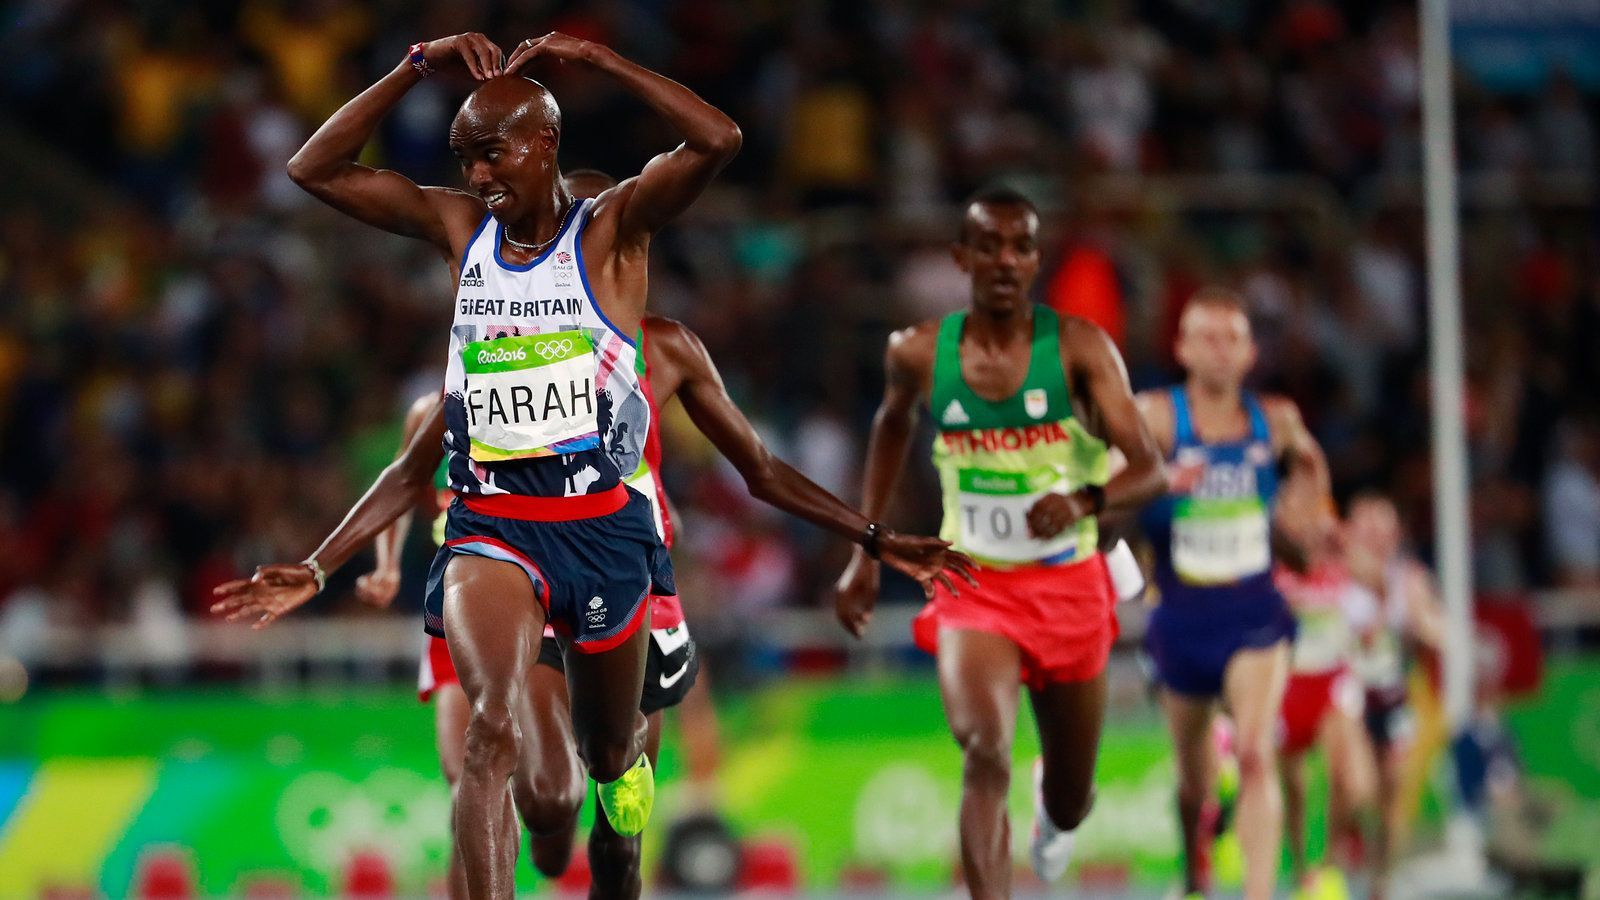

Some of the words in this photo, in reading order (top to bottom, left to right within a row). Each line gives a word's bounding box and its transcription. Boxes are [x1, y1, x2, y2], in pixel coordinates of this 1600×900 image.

[460, 278, 485, 288] addas
[459, 298, 505, 316] GREAT
[510, 298, 583, 318] BRITAIN
[477, 346, 527, 365] Rio2016
[467, 377, 593, 426] FARAH
[962, 504, 1013, 540] TO
